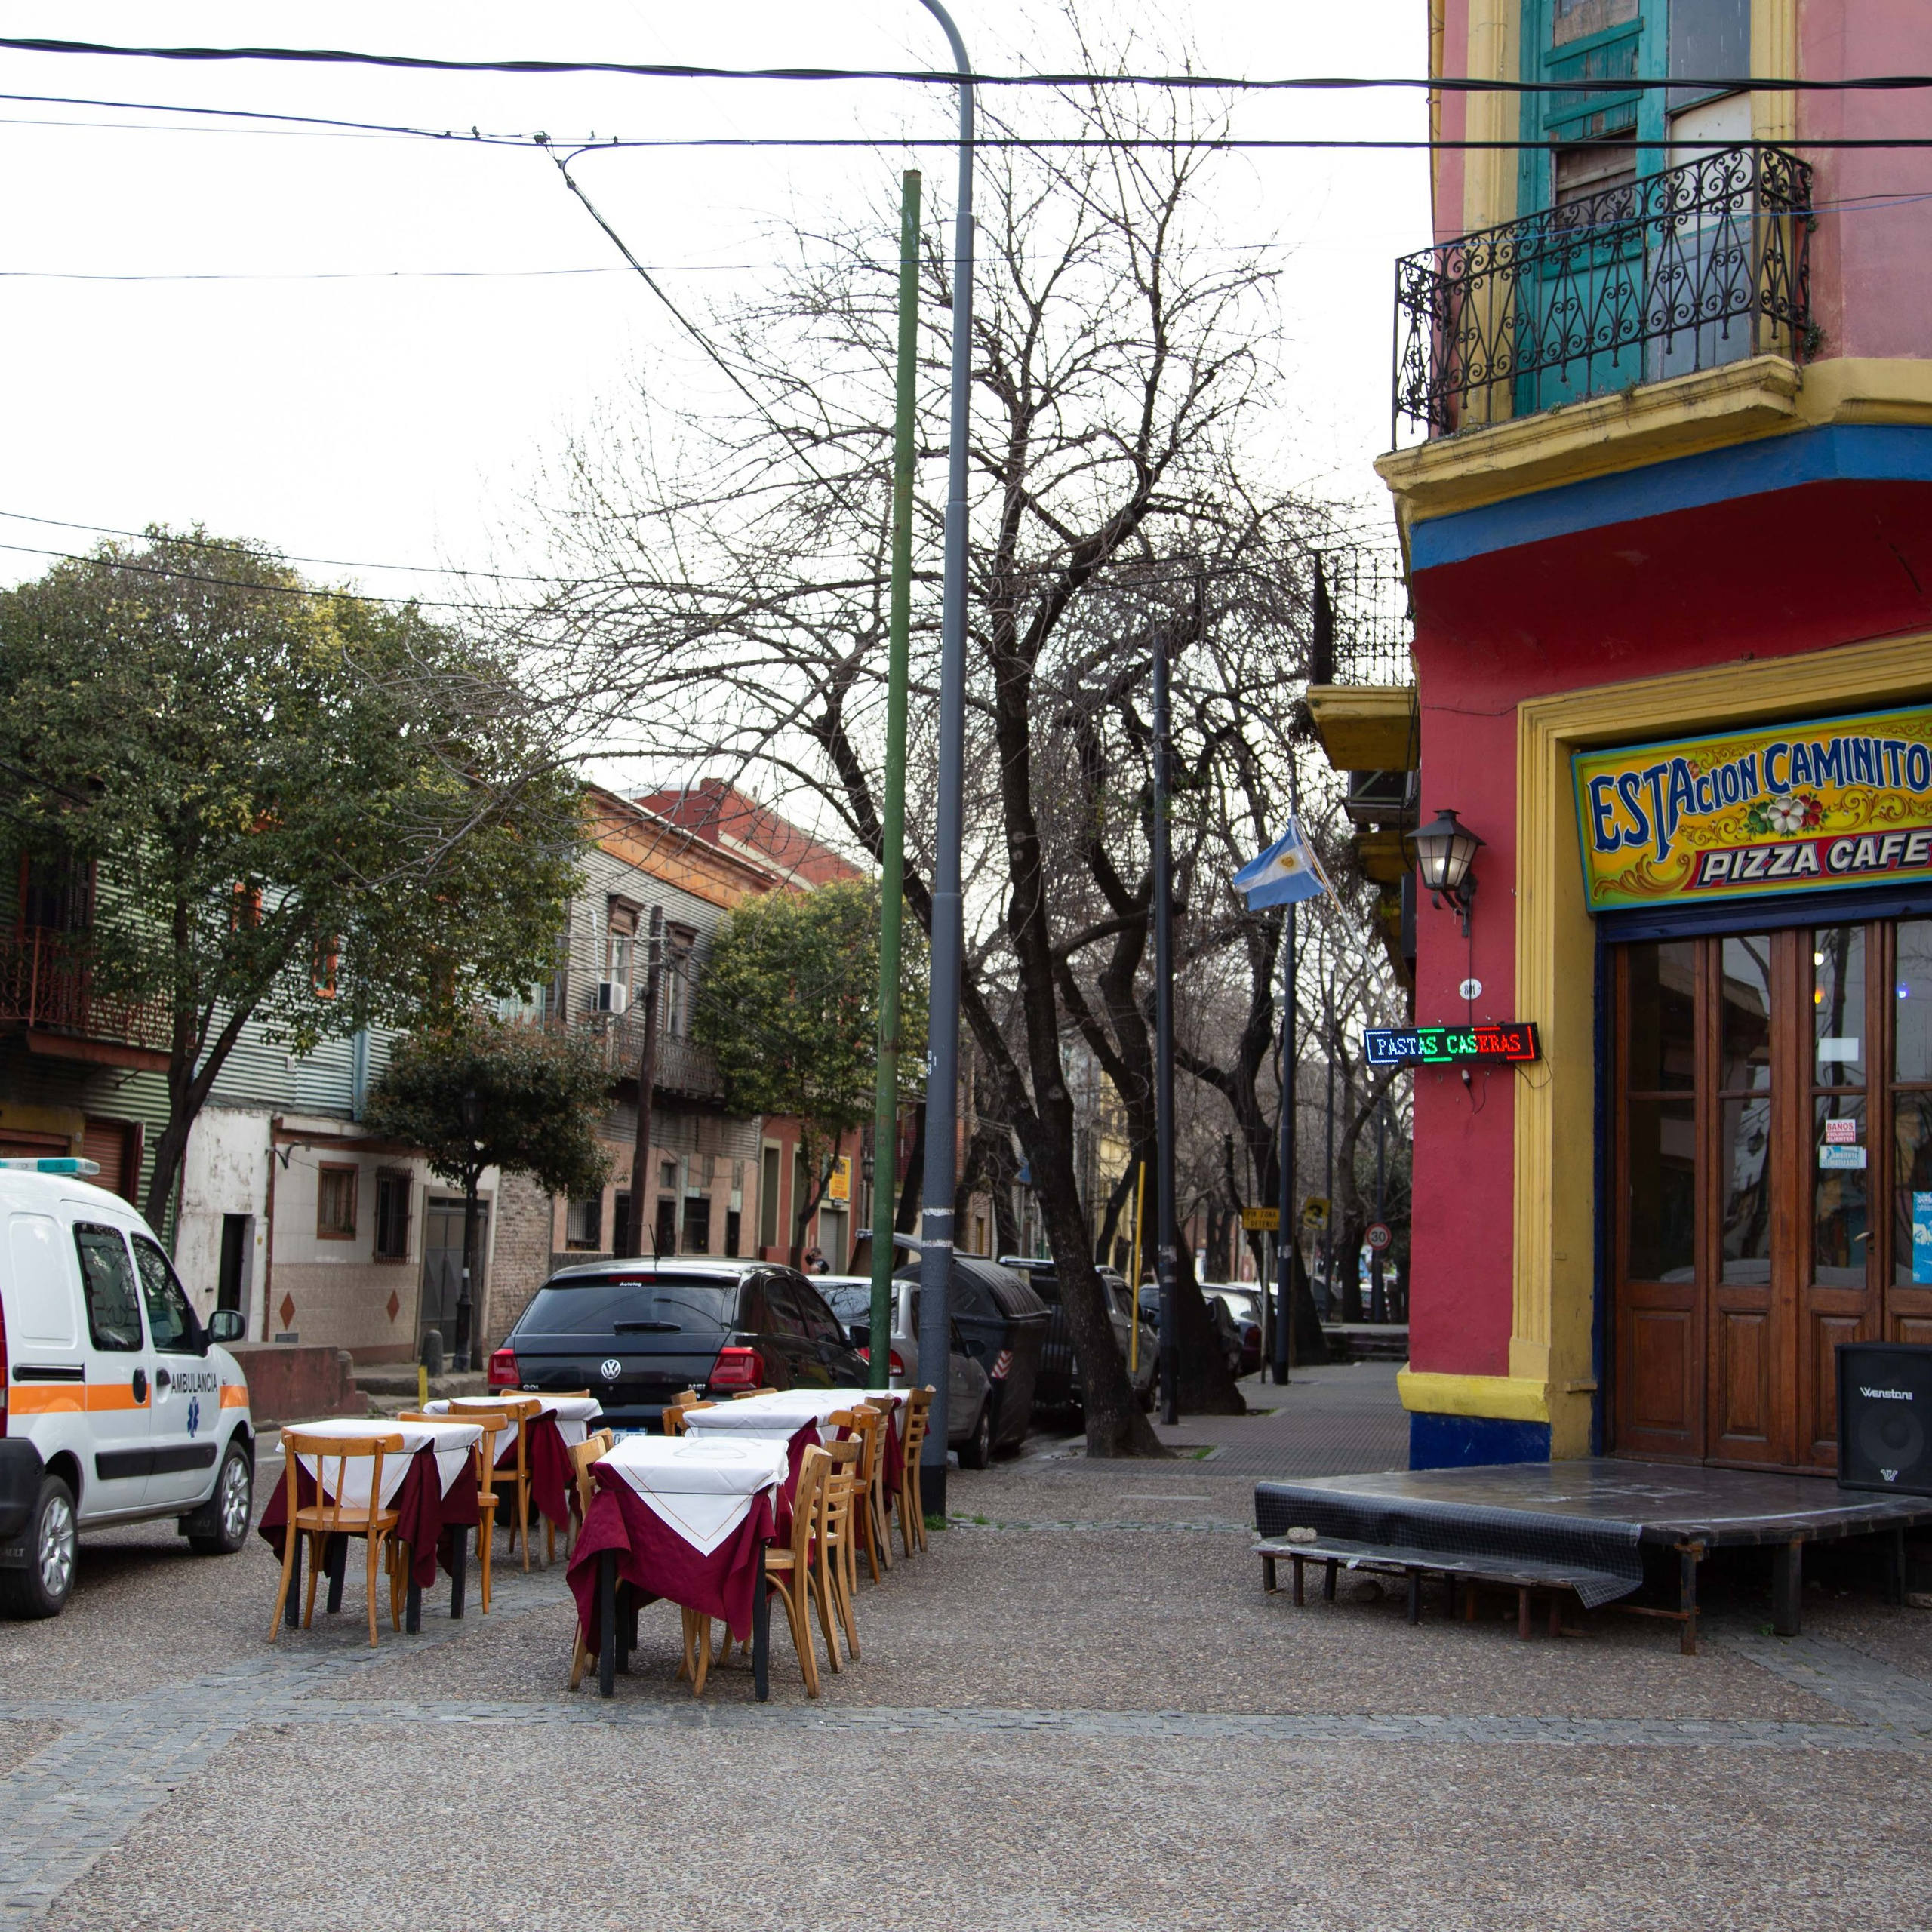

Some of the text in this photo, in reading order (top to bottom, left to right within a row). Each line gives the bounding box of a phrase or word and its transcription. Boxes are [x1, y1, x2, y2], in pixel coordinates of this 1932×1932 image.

[1587, 735, 1932, 863] ESTACION CAMINITO
[1698, 831, 1932, 886] PIZZA CAFE
[1377, 1033, 1521, 1056] PASTAS CASERAS
[1826, 1121, 1854, 1131] BAÑOS
[1371, 1232, 1386, 1243] 30
[171, 1373, 218, 1394] AMBULANCIA
